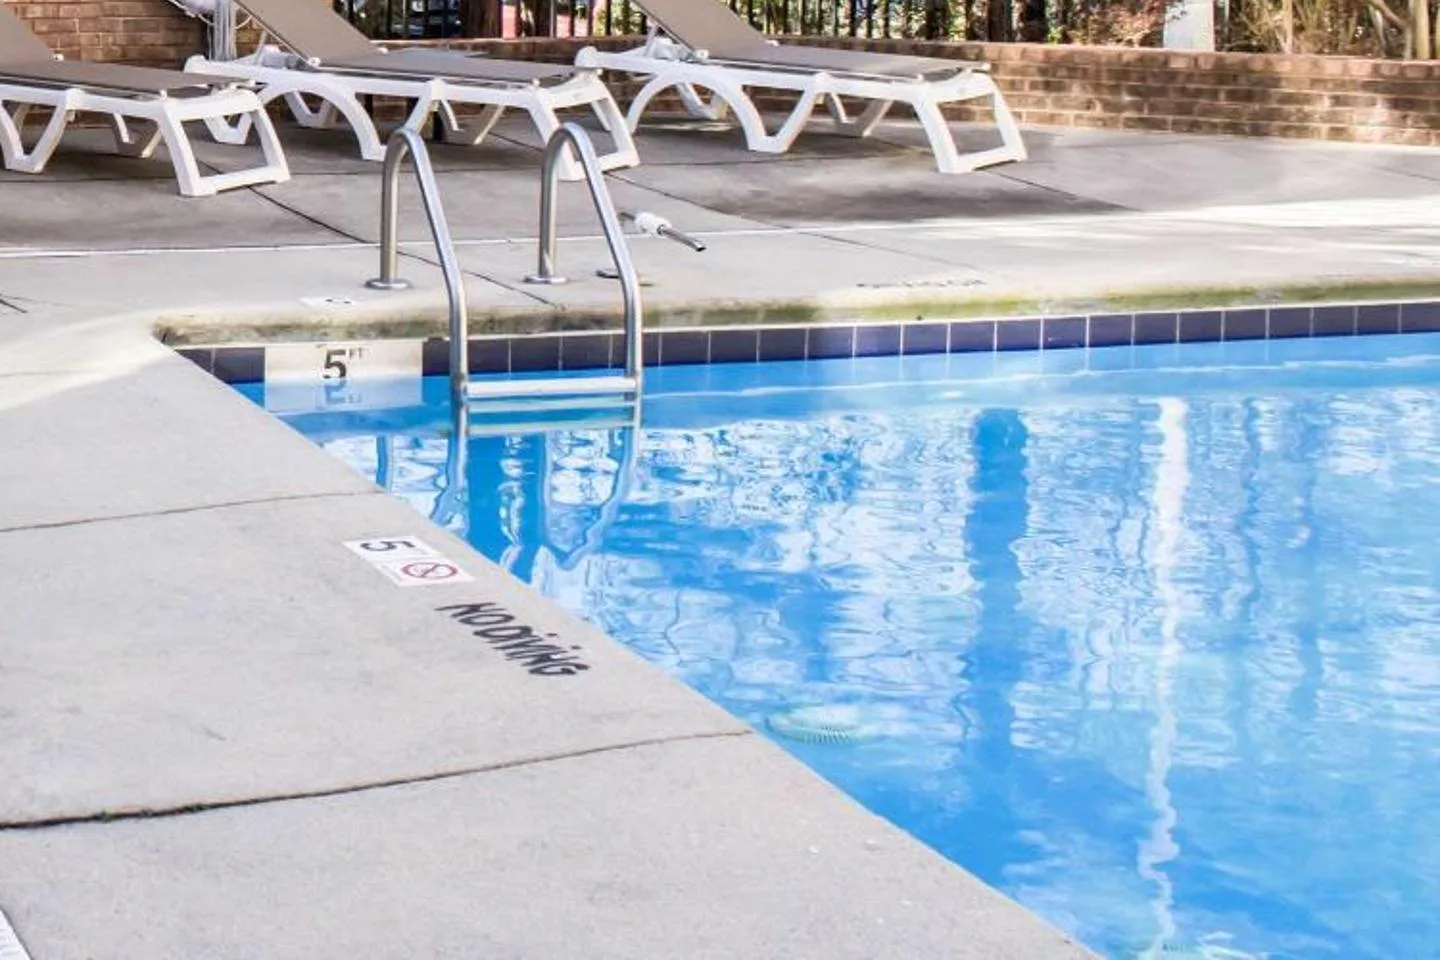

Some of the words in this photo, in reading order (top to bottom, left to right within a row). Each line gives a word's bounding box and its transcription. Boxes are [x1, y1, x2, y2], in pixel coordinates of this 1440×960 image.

[323, 349, 347, 379] 5
[360, 540, 416, 552] 5
[433, 602, 516, 626] NO
